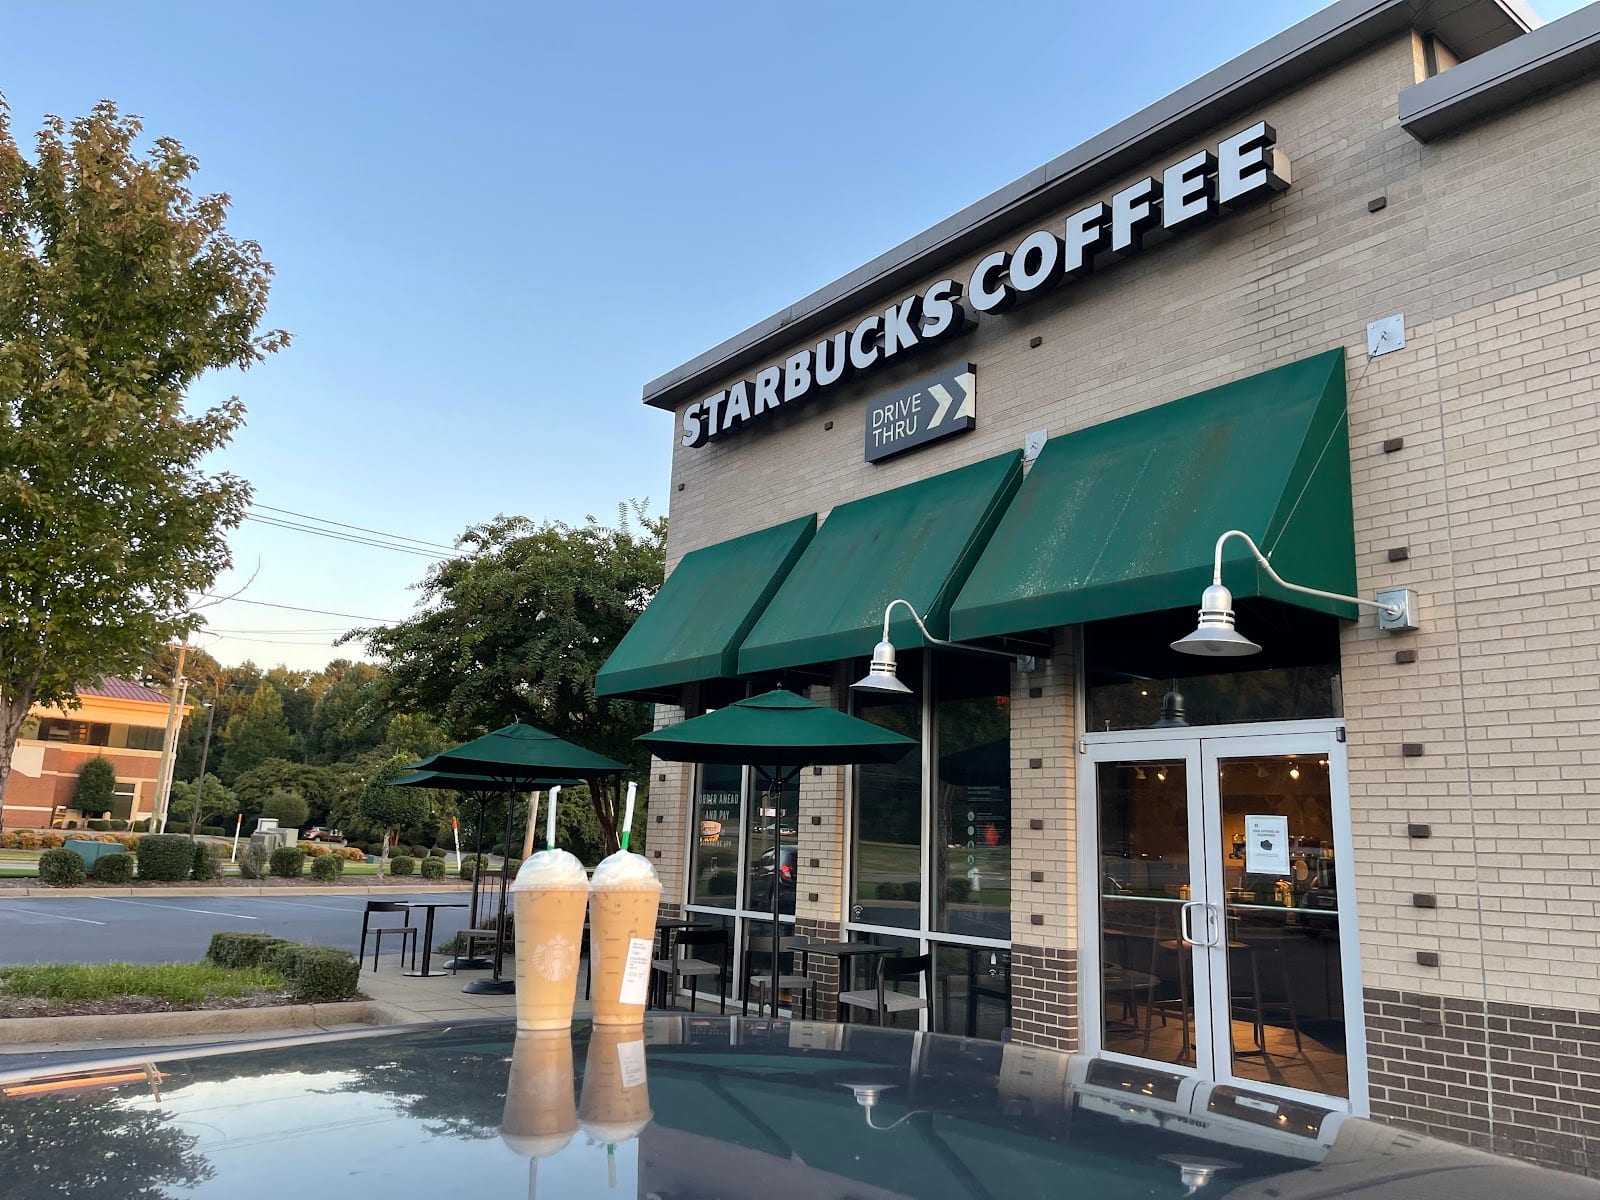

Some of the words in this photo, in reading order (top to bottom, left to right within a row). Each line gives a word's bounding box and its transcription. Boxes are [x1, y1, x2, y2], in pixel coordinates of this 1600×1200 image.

[682, 280, 956, 448] STARBUCKS
[968, 121, 1269, 312] COFFEE
[873, 393, 921, 428] DRIVE
[873, 415, 917, 447] THRU
[699, 794, 717, 804] ORDER
[719, 794, 738, 804] AHEAD
[705, 810, 717, 820] AND
[719, 810, 729, 820] PAY
